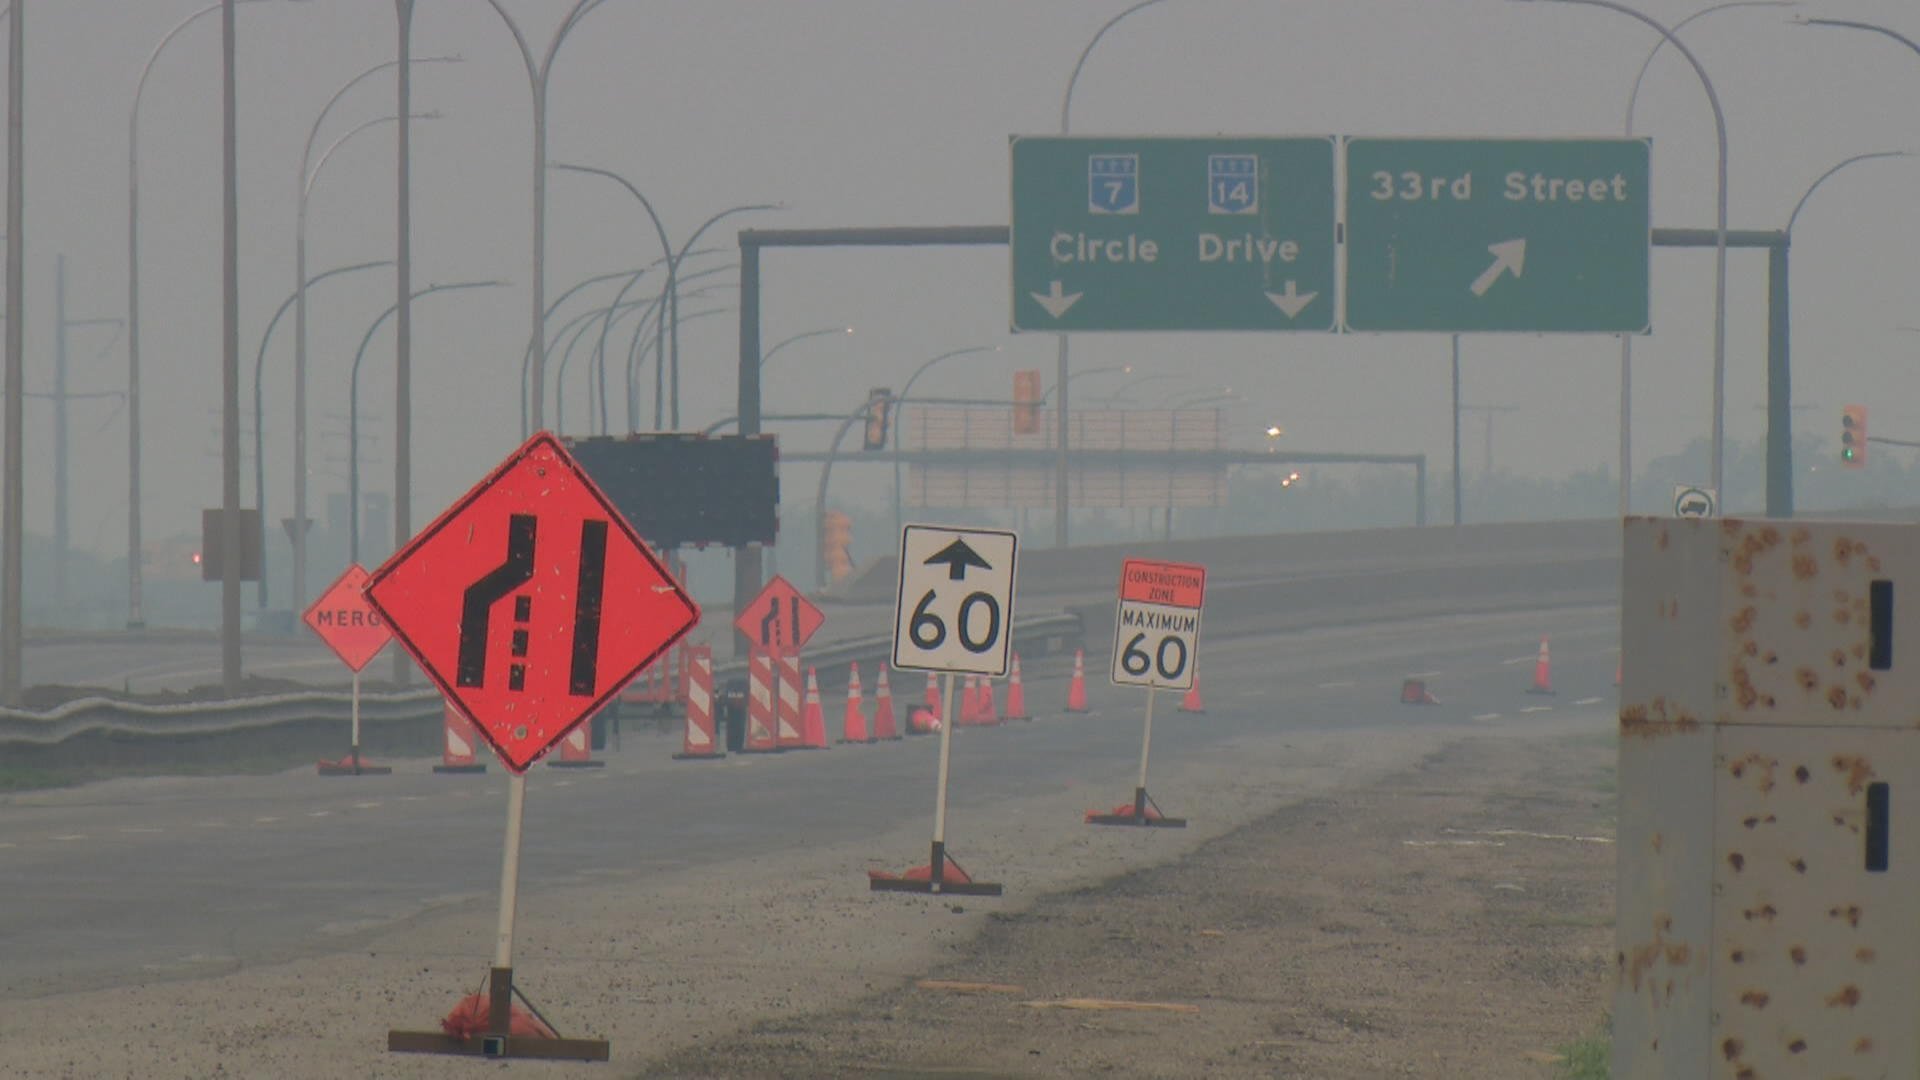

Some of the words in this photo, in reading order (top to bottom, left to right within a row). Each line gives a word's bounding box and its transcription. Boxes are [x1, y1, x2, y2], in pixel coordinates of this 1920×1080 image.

[1104, 181, 1124, 205] 7
[1217, 181, 1249, 205] 14
[1371, 170, 1473, 201] 33rd
[1503, 171, 1628, 201] Street
[1050, 233, 1159, 263] Circle
[1199, 233, 1299, 263] Drive
[1128, 569, 1200, 588] CONSTRUCTION
[1148, 587, 1176, 602] ZONE
[317, 610, 381, 626] MERG
[908, 588, 1000, 654] 60
[1122, 609, 1196, 633] MAXIMUM
[1121, 633, 1187, 680] 60
